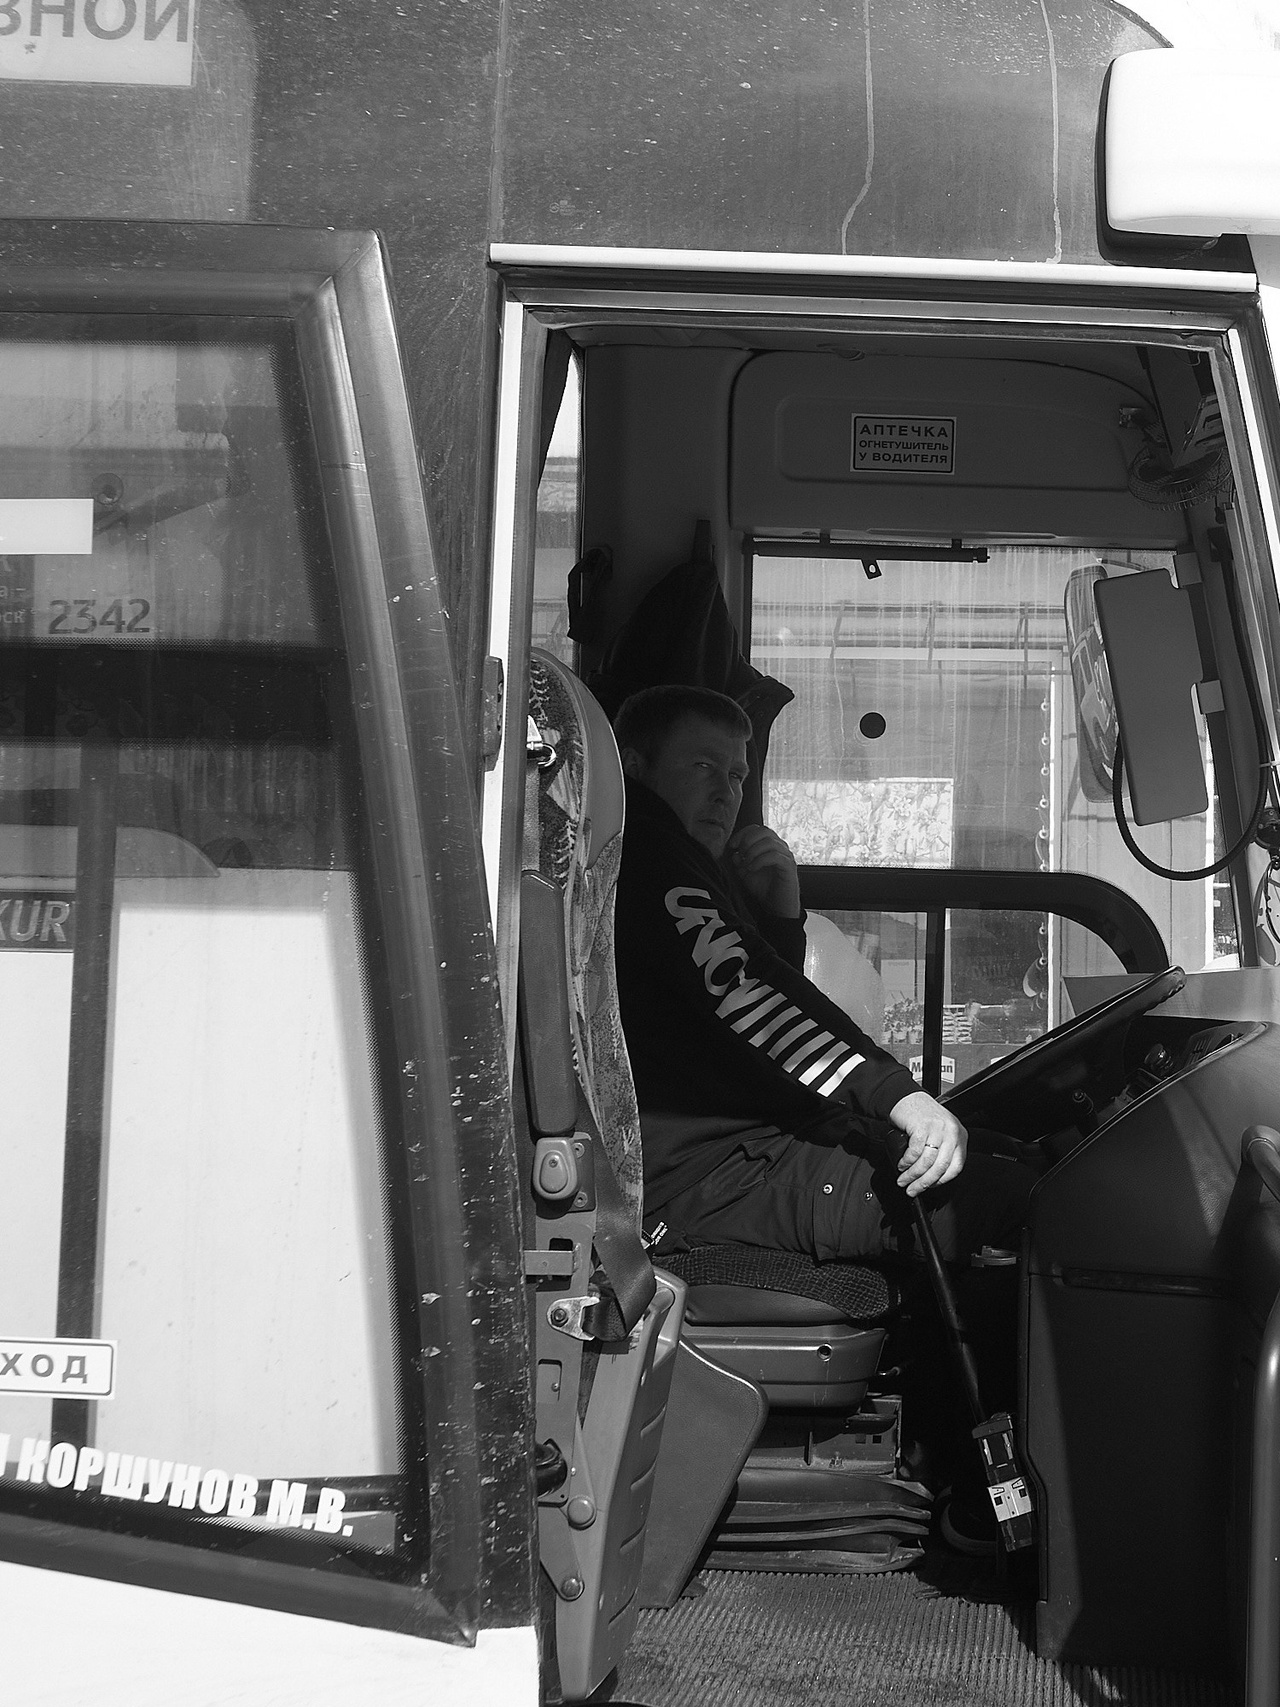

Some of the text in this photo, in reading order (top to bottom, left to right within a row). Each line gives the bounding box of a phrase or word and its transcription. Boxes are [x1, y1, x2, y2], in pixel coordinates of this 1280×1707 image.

[859, 424, 948, 438] АПТЕЧКА
[859, 440, 949, 451] ОГНЕТУШИТЕЛЬ
[859, 452, 948, 464] У ВОДИТЕЛЯ
[48, 598, 151, 635] 2342
[15, 1437, 260, 1518] КОРШУНОВ
[265, 1479, 354, 1537] М.В.
